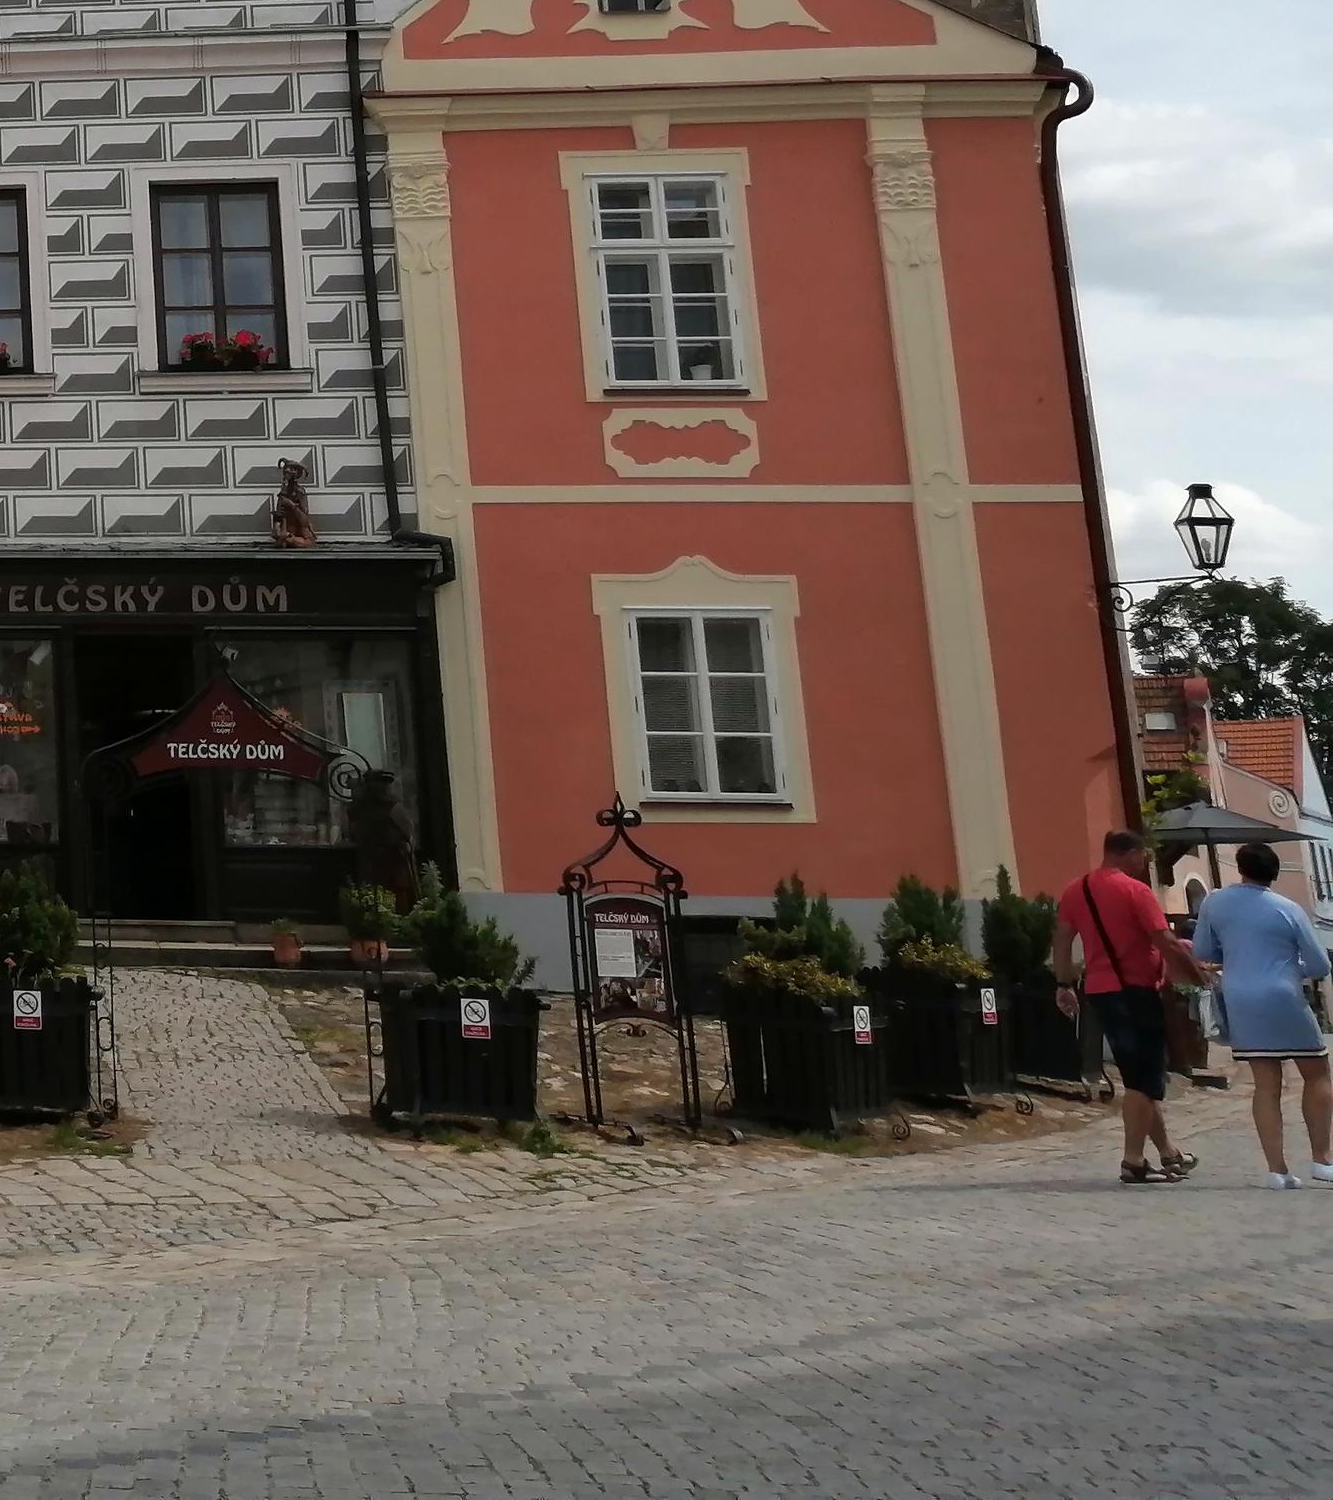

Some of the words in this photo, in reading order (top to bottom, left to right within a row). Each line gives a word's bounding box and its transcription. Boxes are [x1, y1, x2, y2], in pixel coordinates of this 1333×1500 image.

[191, 576, 288, 613] DŮM
[167, 738, 241, 760] TELČSKÝ
[245, 739, 285, 760] DŮM
[594, 911, 629, 923] TELČSKÝ
[630, 912, 649, 924] DŮM
